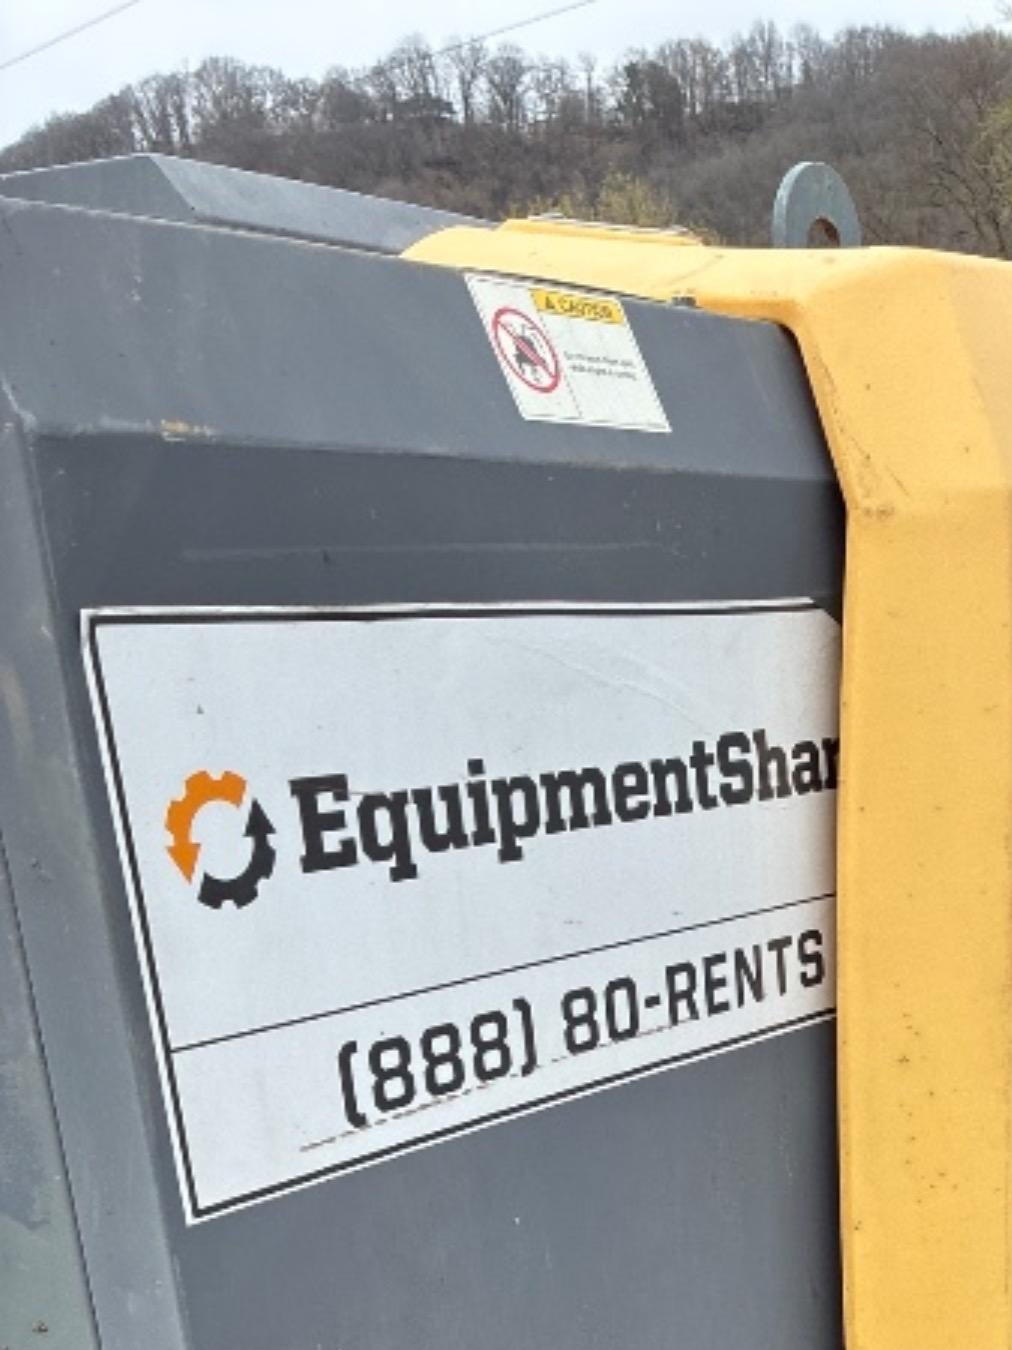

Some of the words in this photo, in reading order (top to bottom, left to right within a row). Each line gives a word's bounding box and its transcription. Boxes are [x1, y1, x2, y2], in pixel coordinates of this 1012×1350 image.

[290, 728, 839, 882] EquipmentShar
[338, 999, 537, 1128] (888)
[562, 929, 826, 1055] 80-RENTS
